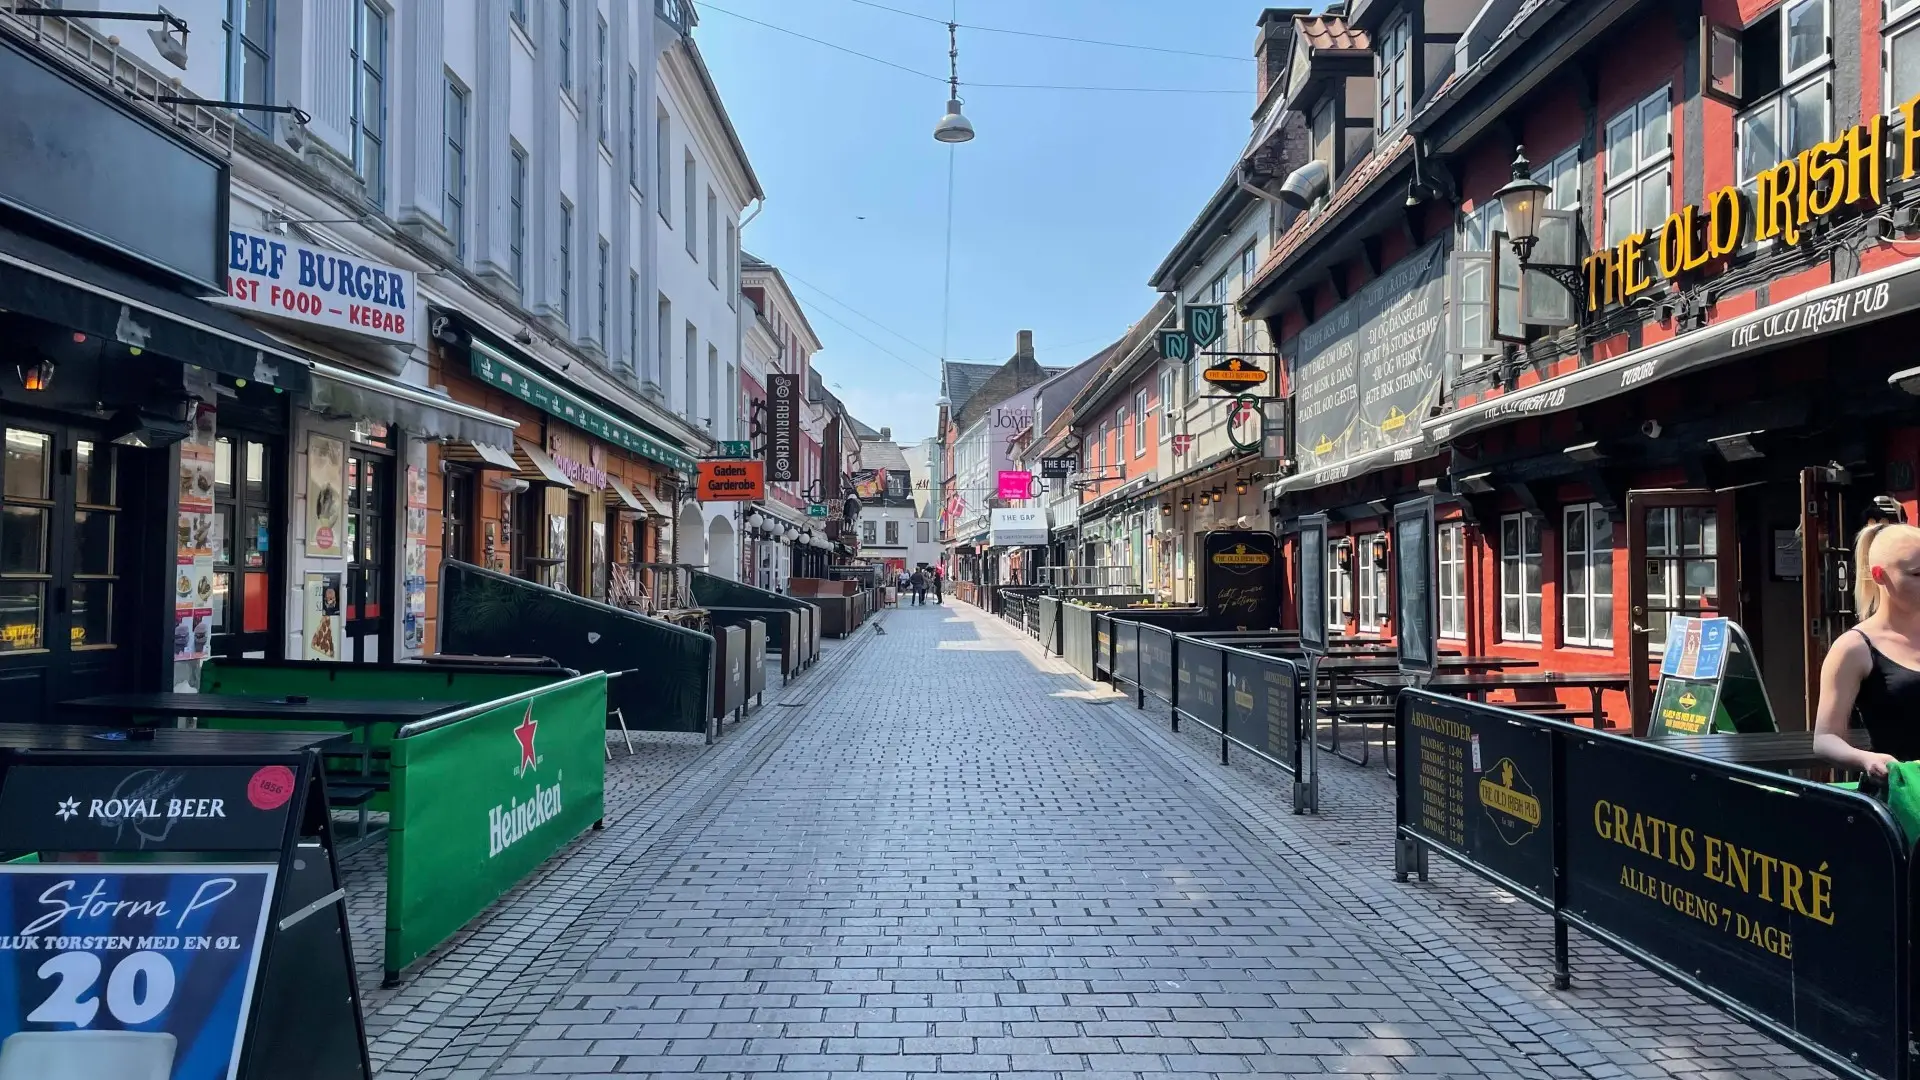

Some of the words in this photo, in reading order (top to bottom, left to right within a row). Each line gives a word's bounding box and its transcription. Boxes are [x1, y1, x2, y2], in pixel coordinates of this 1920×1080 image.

[1582, 229, 1651, 312] THE
[1660, 186, 1740, 279] OLD
[1756, 114, 1881, 246] IRISH
[229, 230, 287, 280] EEF
[298, 249, 406, 310] BURGER
[271, 286, 322, 316] FOOD
[350, 304, 405, 334] KEBAB
[1390, 297, 1429, 332] DANSEGULV
[1802, 295, 1851, 335] IRISH
[1852, 282, 1890, 316] PUB
[1336, 362, 1352, 384] DANS
[1383, 358, 1395, 376] OG
[1396, 345, 1422, 370] WHISKY
[1396, 363, 1432, 392] STEMNING
[1620, 359, 1658, 388] TUBORG
[1544, 388, 1566, 408] PUB
[776, 400, 790, 458] FABRIKKEN
[714, 465, 746, 477] Gadens
[1044, 460, 1059, 469] THE
[1060, 460, 1075, 469] GAP
[708, 480, 755, 491] Garderobe
[1411, 708, 1472, 742] ÅBNINGSTIDER
[1449, 745, 1462, 759] 12-05
[260, 780, 283, 794] 1856
[1480, 784, 1492, 801] THE
[1494, 789, 1506, 808] OLD
[1508, 794, 1524, 816] IRISH
[1524, 801, 1538, 819] PUB
[88, 799, 162, 818] ROYAL
[167, 799, 227, 818] BEER
[489, 783, 562, 858] Heineken
[1594, 799, 1696, 871] GRATIS
[1703, 834, 1835, 926] ENTRÉ
[20, 878, 172, 936] Storm
[176, 878, 237, 930] P
[1620, 865, 1658, 900] ALLE
[1660, 881, 1718, 927] UGENS
[1722, 908, 1732, 932] 7
[1736, 913, 1793, 960] DAGE
[0, 936, 40, 950] LUK
[44, 936, 134, 950] TØRSTEN
[136, 936, 180, 950] MED
[183, 936, 210, 950] EN
[215, 936, 241, 950] ØL
[26, 950, 176, 1028] 20
